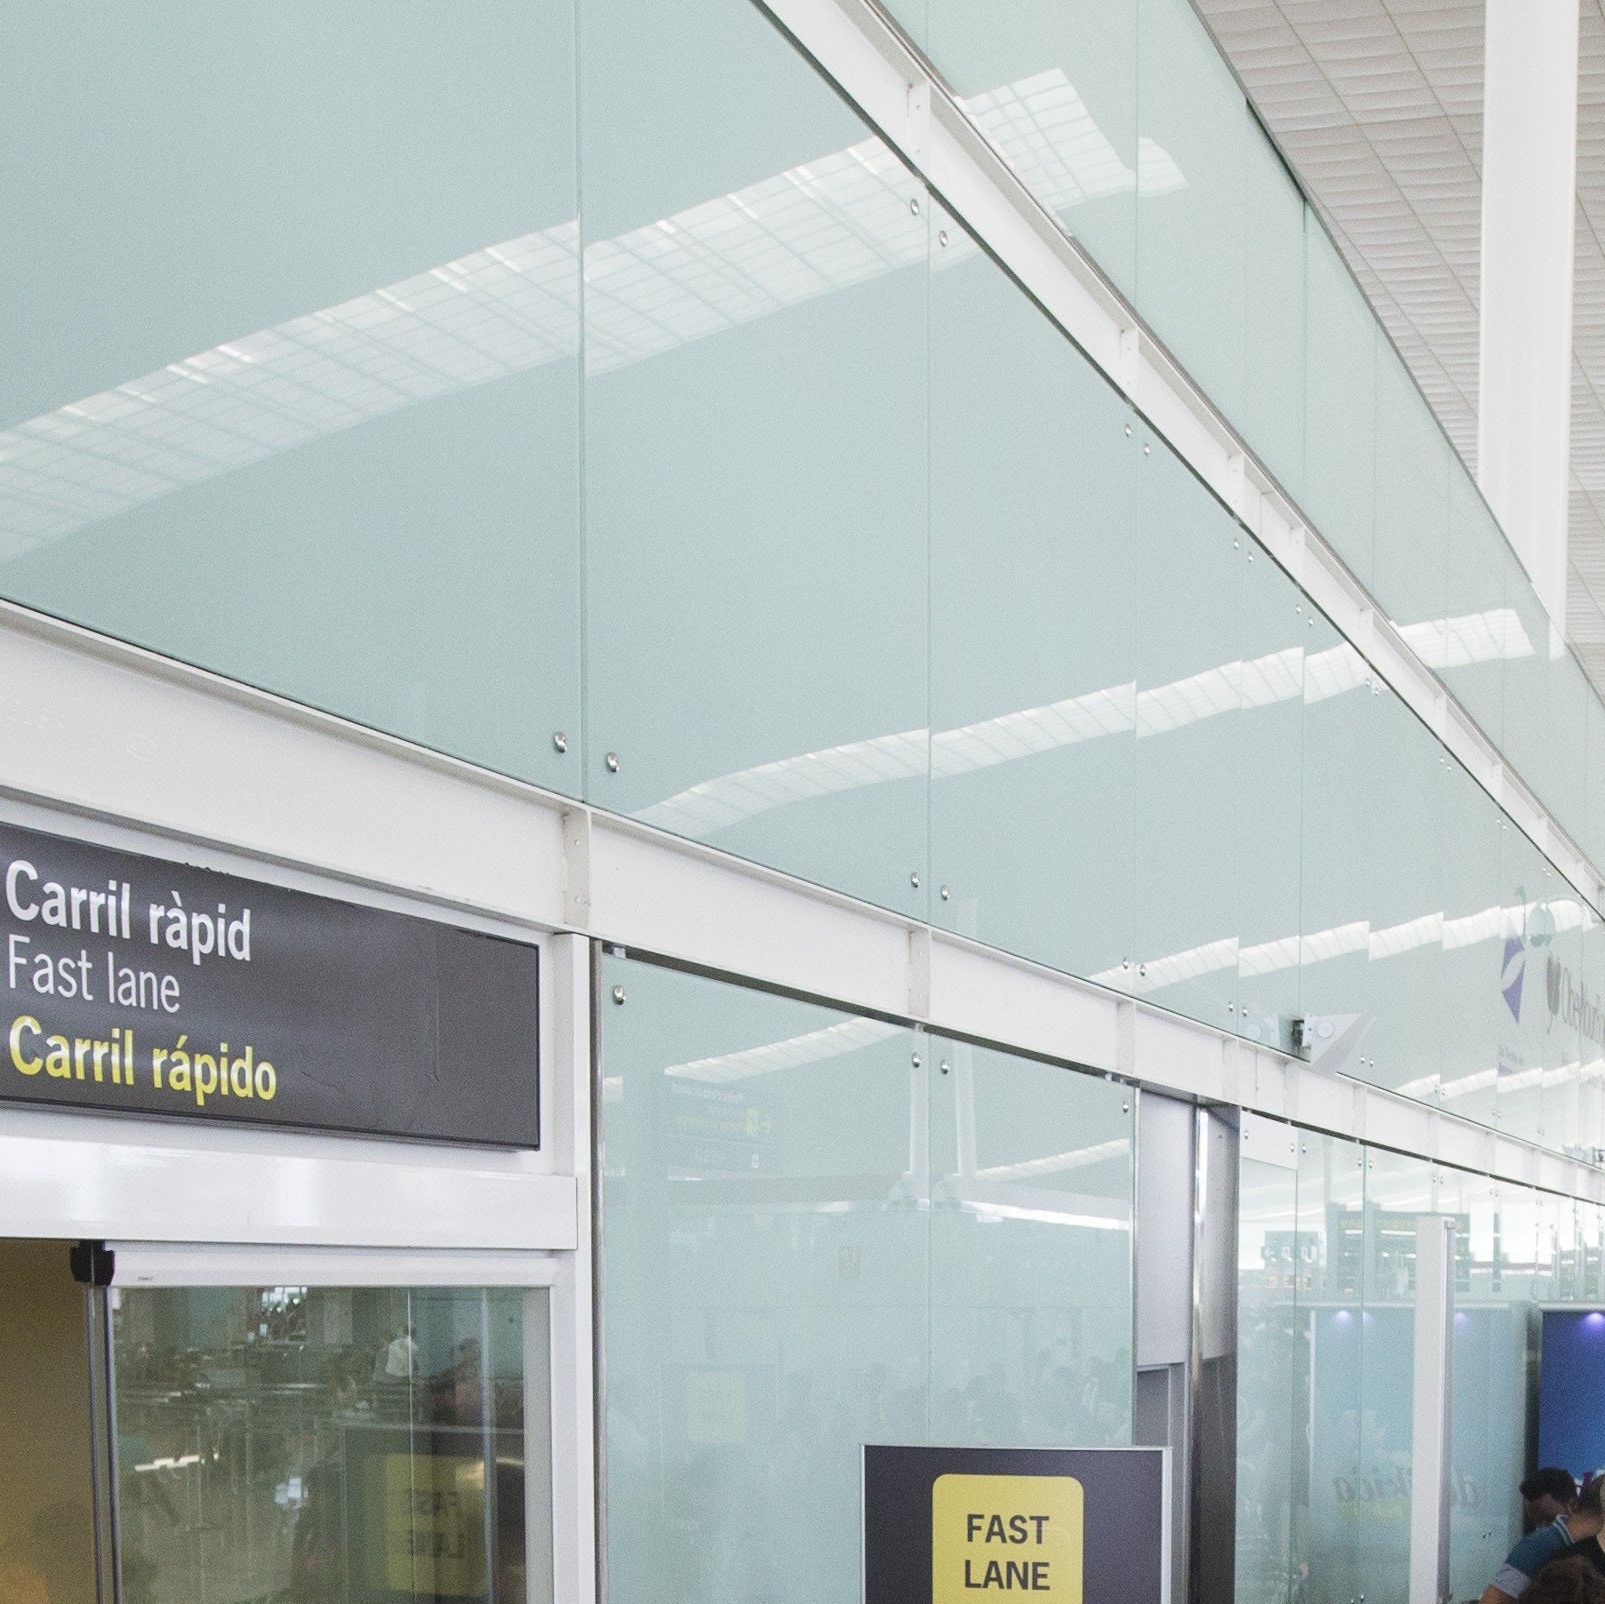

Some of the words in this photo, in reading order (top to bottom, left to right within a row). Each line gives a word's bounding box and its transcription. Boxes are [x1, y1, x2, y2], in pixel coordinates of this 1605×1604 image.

[5, 858, 132, 938] Carril
[148, 891, 253, 965] ràpid
[8, 934, 92, 1000] Fast
[107, 949, 180, 1013] lane
[8, 1015, 135, 1087] Carril
[151, 1033, 277, 1106] rápido
[966, 1513, 1050, 1545] FAST
[963, 1559, 1051, 1591] LANE
